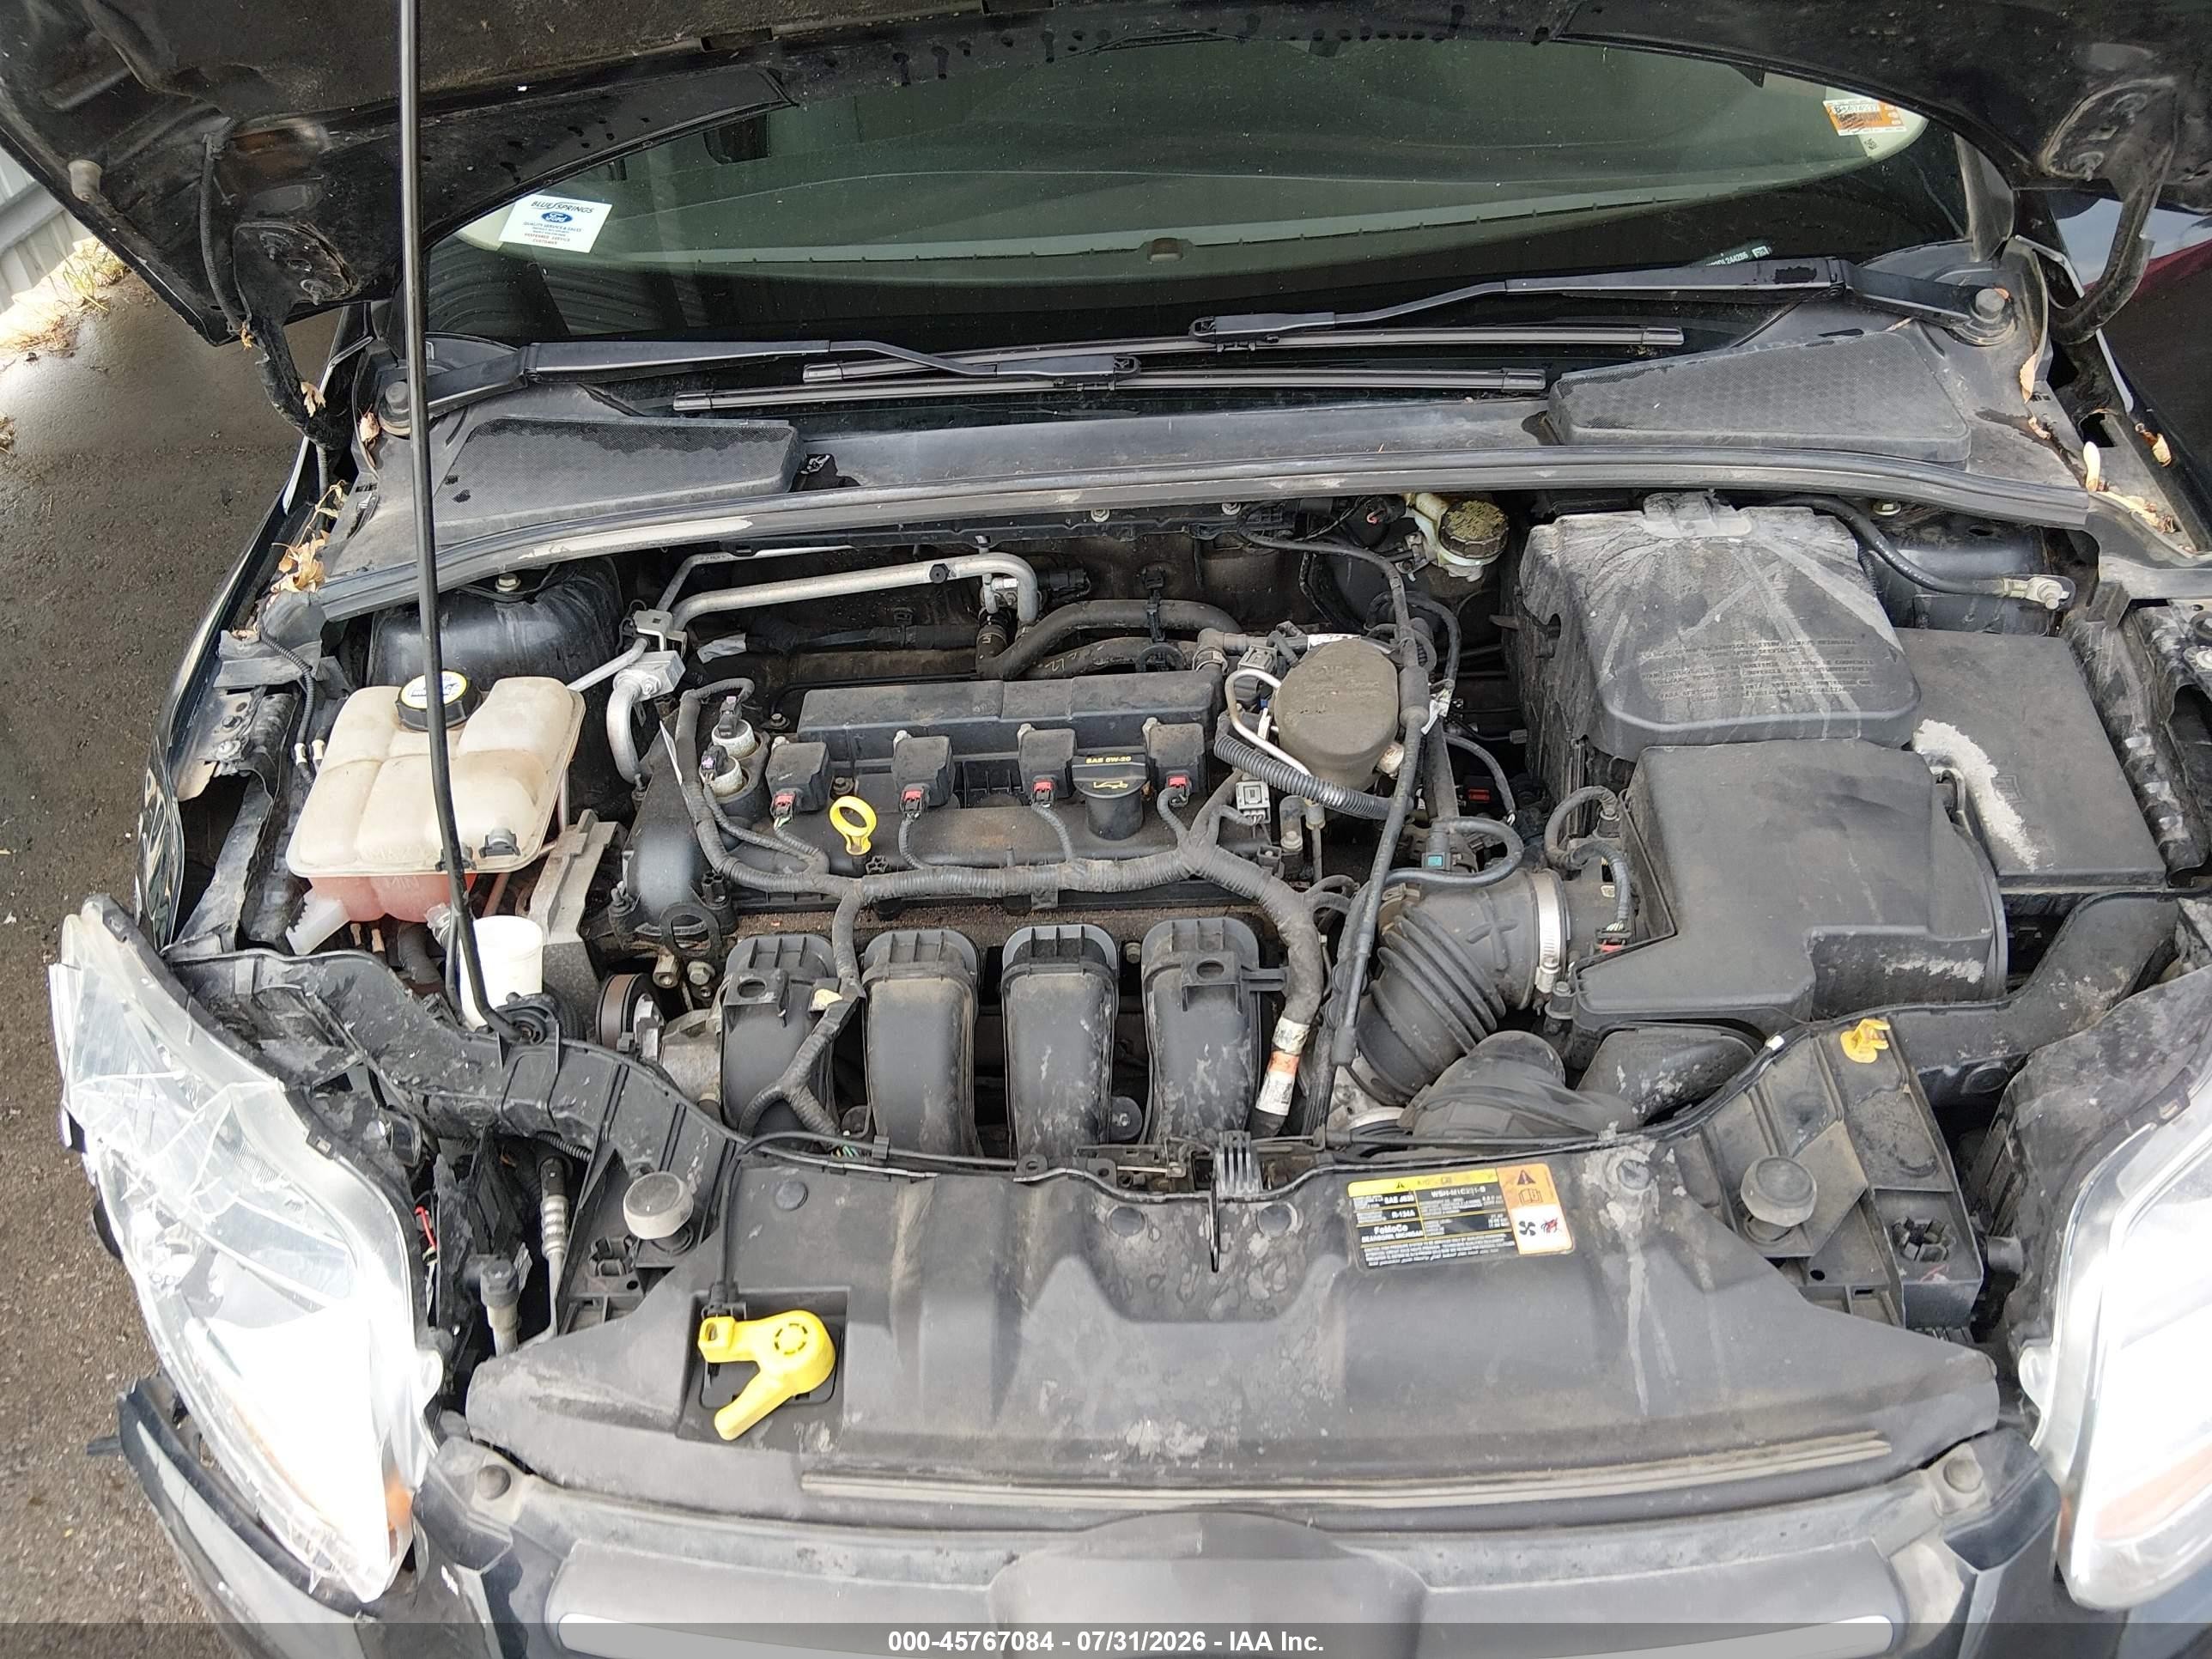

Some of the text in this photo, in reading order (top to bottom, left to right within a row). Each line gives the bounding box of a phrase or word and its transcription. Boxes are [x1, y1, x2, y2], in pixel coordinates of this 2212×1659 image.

[555, 203, 594, 213] SPRINGS
[1391, 1209, 1416, 1219] R-134A
[1374, 1224, 1408, 1235] FoMoCo
